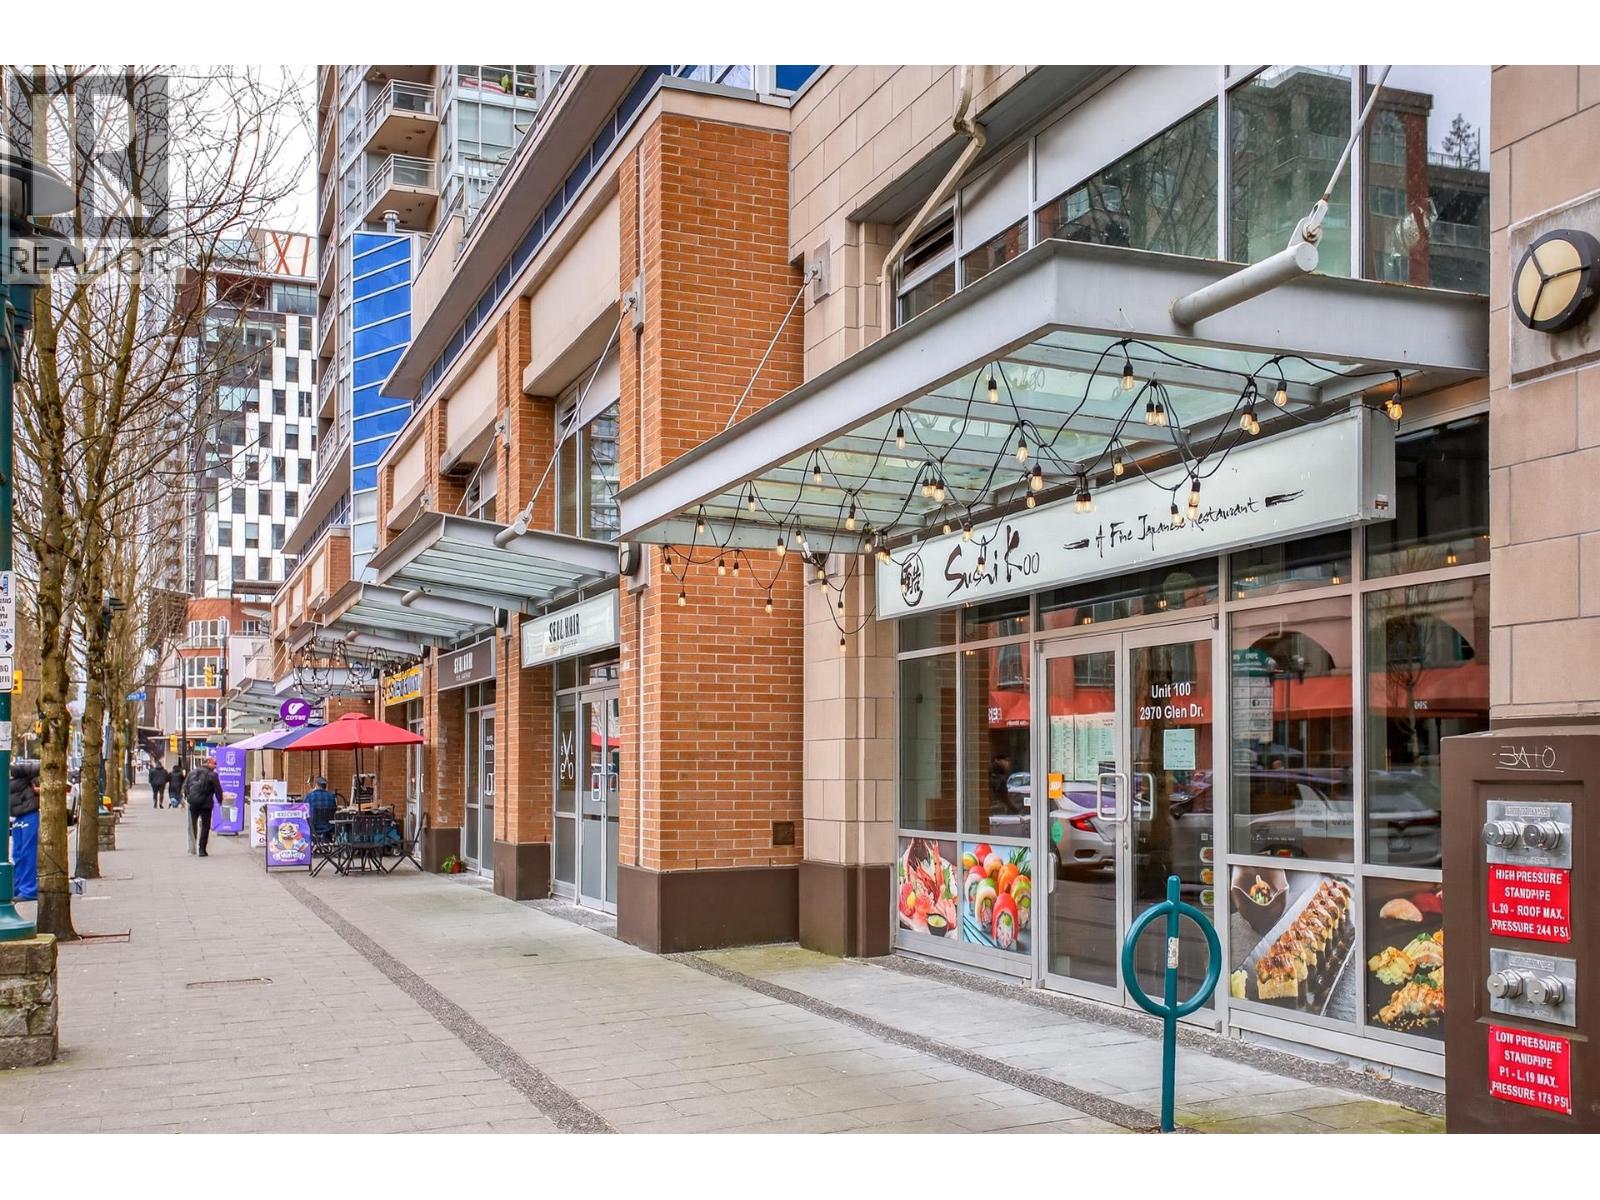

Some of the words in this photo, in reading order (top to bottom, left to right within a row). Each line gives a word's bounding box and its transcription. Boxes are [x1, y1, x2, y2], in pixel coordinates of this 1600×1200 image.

[1095, 523, 1105, 558] A
[1110, 521, 1133, 548] Fine
[1138, 514, 1185, 551] Japanese
[944, 534, 998, 598] Sushi
[1003, 525, 1040, 583] Koo
[1151, 684, 1171, 699] Unit
[1173, 682, 1191, 697] 100
[1139, 706, 1161, 720] 2970
[1164, 705, 1187, 719] Glen
[1190, 703, 1204, 718] Dr.
[1516, 870, 1563, 885] PRESSURE
[1504, 886, 1551, 902] STANDPIPE
[1517, 904, 1541, 917] ROOF
[1543, 907, 1565, 920] MAX.
[1491, 918, 1535, 934] PRESSURE
[1536, 924, 1552, 936] 244
[1553, 925, 1569, 938] PSI
[1495, 1031, 1514, 1044] LOW
[1515, 1034, 1562, 1053] PRESSURE
[1504, 1049, 1552, 1069] STANDPIPE
[1499, 1065, 1509, 1077] P1
[1517, 1069, 1535, 1083] L.19
[1537, 1073, 1559, 1088] MAX.
[1491, 1080, 1536, 1101] PRESSURE
[1538, 1091, 1552, 1105] 175
[1554, 1095, 1569, 1109] PSI
